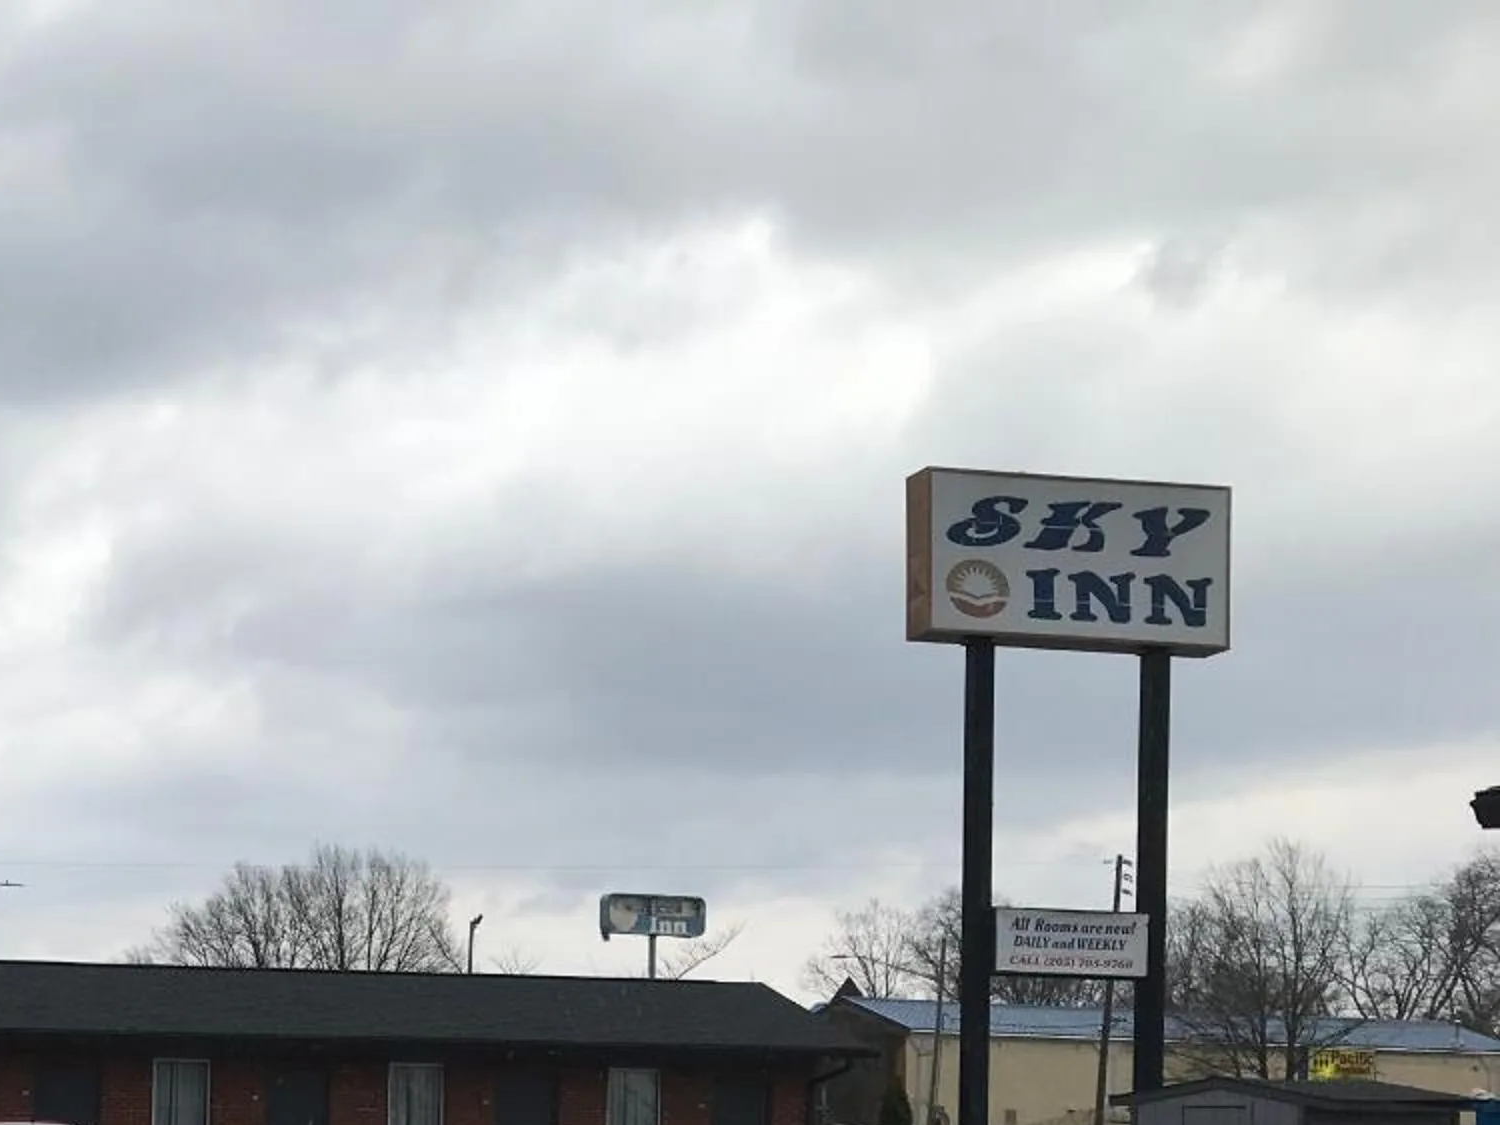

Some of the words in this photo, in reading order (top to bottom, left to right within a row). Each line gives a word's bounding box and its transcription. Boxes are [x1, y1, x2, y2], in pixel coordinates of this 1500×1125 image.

[945, 495, 1211, 558] SKY
[1025, 567, 1213, 627] INN
[1011, 917, 1031, 931] All
[1034, 918, 1078, 933] Rooms
[1080, 922, 1102, 935] are
[1013, 935, 1050, 949] DAILY
[1051, 937, 1075, 951] and
[1077, 938, 1127, 951] WEEKLY
[1009, 954, 1040, 965] CALL
